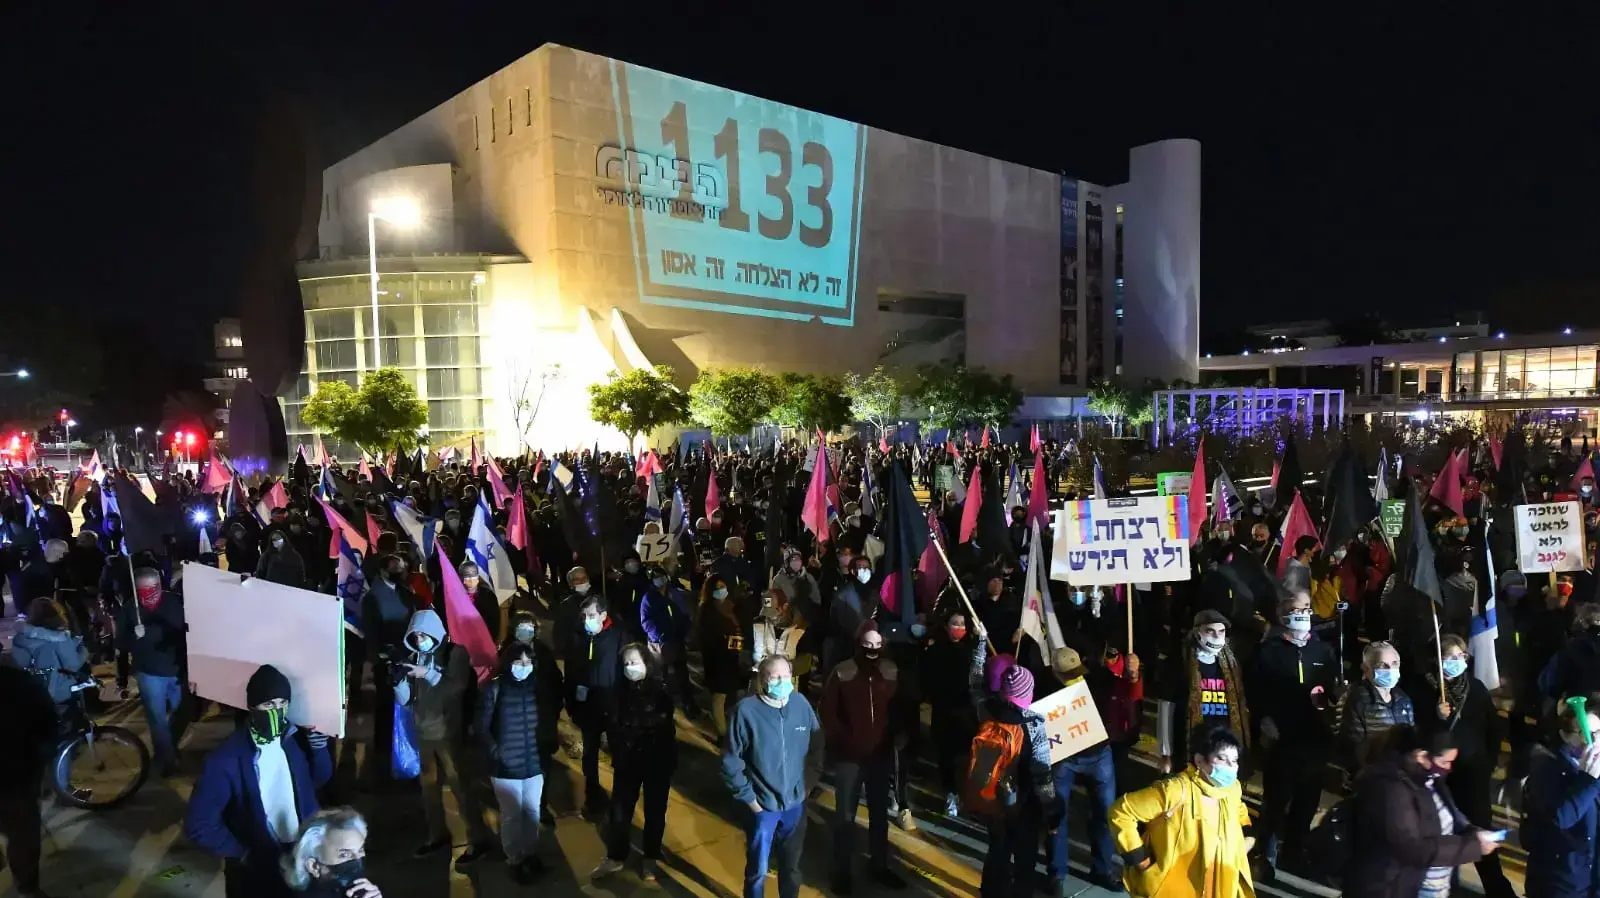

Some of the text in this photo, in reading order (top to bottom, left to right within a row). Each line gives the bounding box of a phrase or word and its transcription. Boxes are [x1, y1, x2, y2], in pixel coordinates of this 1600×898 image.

[596, 144, 727, 207] הבימה
[661, 101, 833, 248] 1133
[661, 249, 698, 276] אסון
[705, 256, 724, 280] זה
[798, 271, 820, 293] לא
[825, 276, 842, 297] זה
[1528, 504, 1568, 517] שנזכה
[1093, 517, 1160, 541] רצחת
[1530, 518, 1568, 532] לראש
[1538, 534, 1562, 547] ולא
[1069, 537, 1182, 571] ולא תירש
[1537, 551, 1567, 562] לגנב
[1047, 695, 1087, 721] זה לא
[1068, 720, 1089, 739] זה
